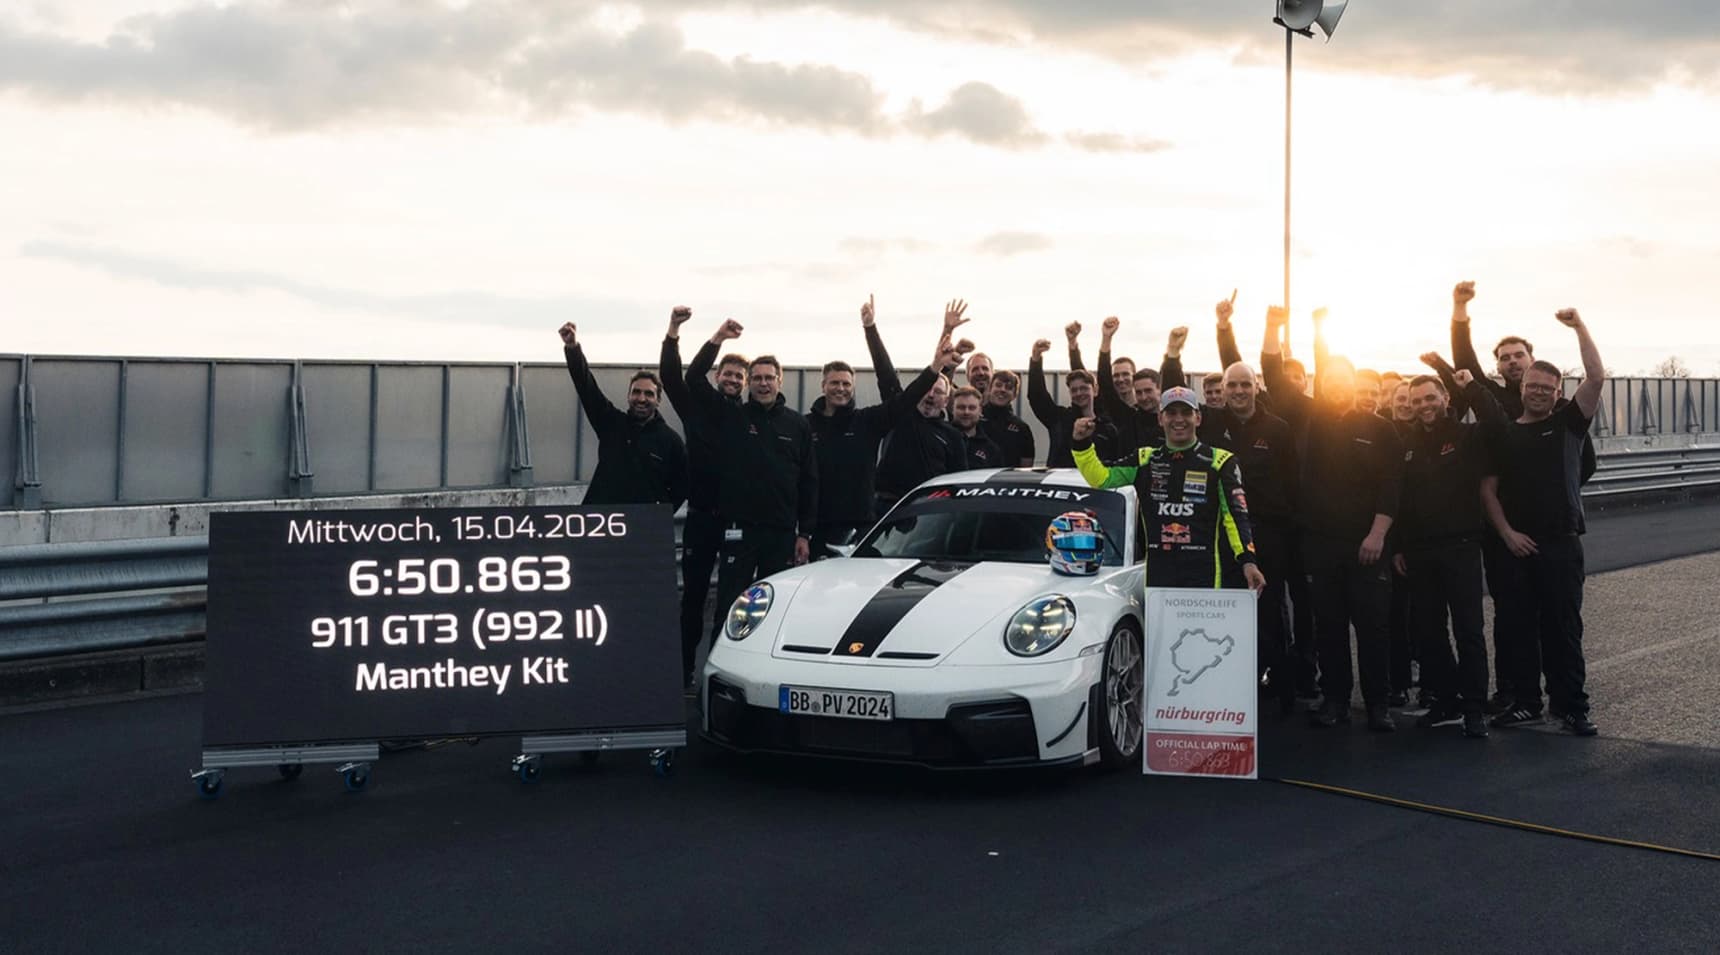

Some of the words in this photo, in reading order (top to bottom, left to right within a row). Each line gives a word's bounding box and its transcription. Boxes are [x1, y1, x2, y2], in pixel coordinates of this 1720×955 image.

[956, 487, 1090, 501] MANTHEY
[288, 515, 441, 544] Mittwoch,
[451, 512, 627, 541] 15.04.2026
[348, 555, 572, 597] 6:50.863
[1165, 598, 1238, 608] NORDSCHLEIFE
[1176, 611, 1205, 619] SPORTS
[311, 616, 369, 648] 911
[381, 613, 459, 645] GT3
[471, 607, 564, 650] (992
[575, 604, 609, 646] II)
[355, 658, 511, 695] Manthey
[522, 656, 569, 685] Kit
[790, 691, 810, 711] BB
[822, 694, 843, 713] PV
[847, 695, 888, 717] 2024
[1155, 706, 1246, 725] nürburgring
[1156, 739, 1200, 750] OFFICIAL
[1201, 741, 1220, 750] LAP
